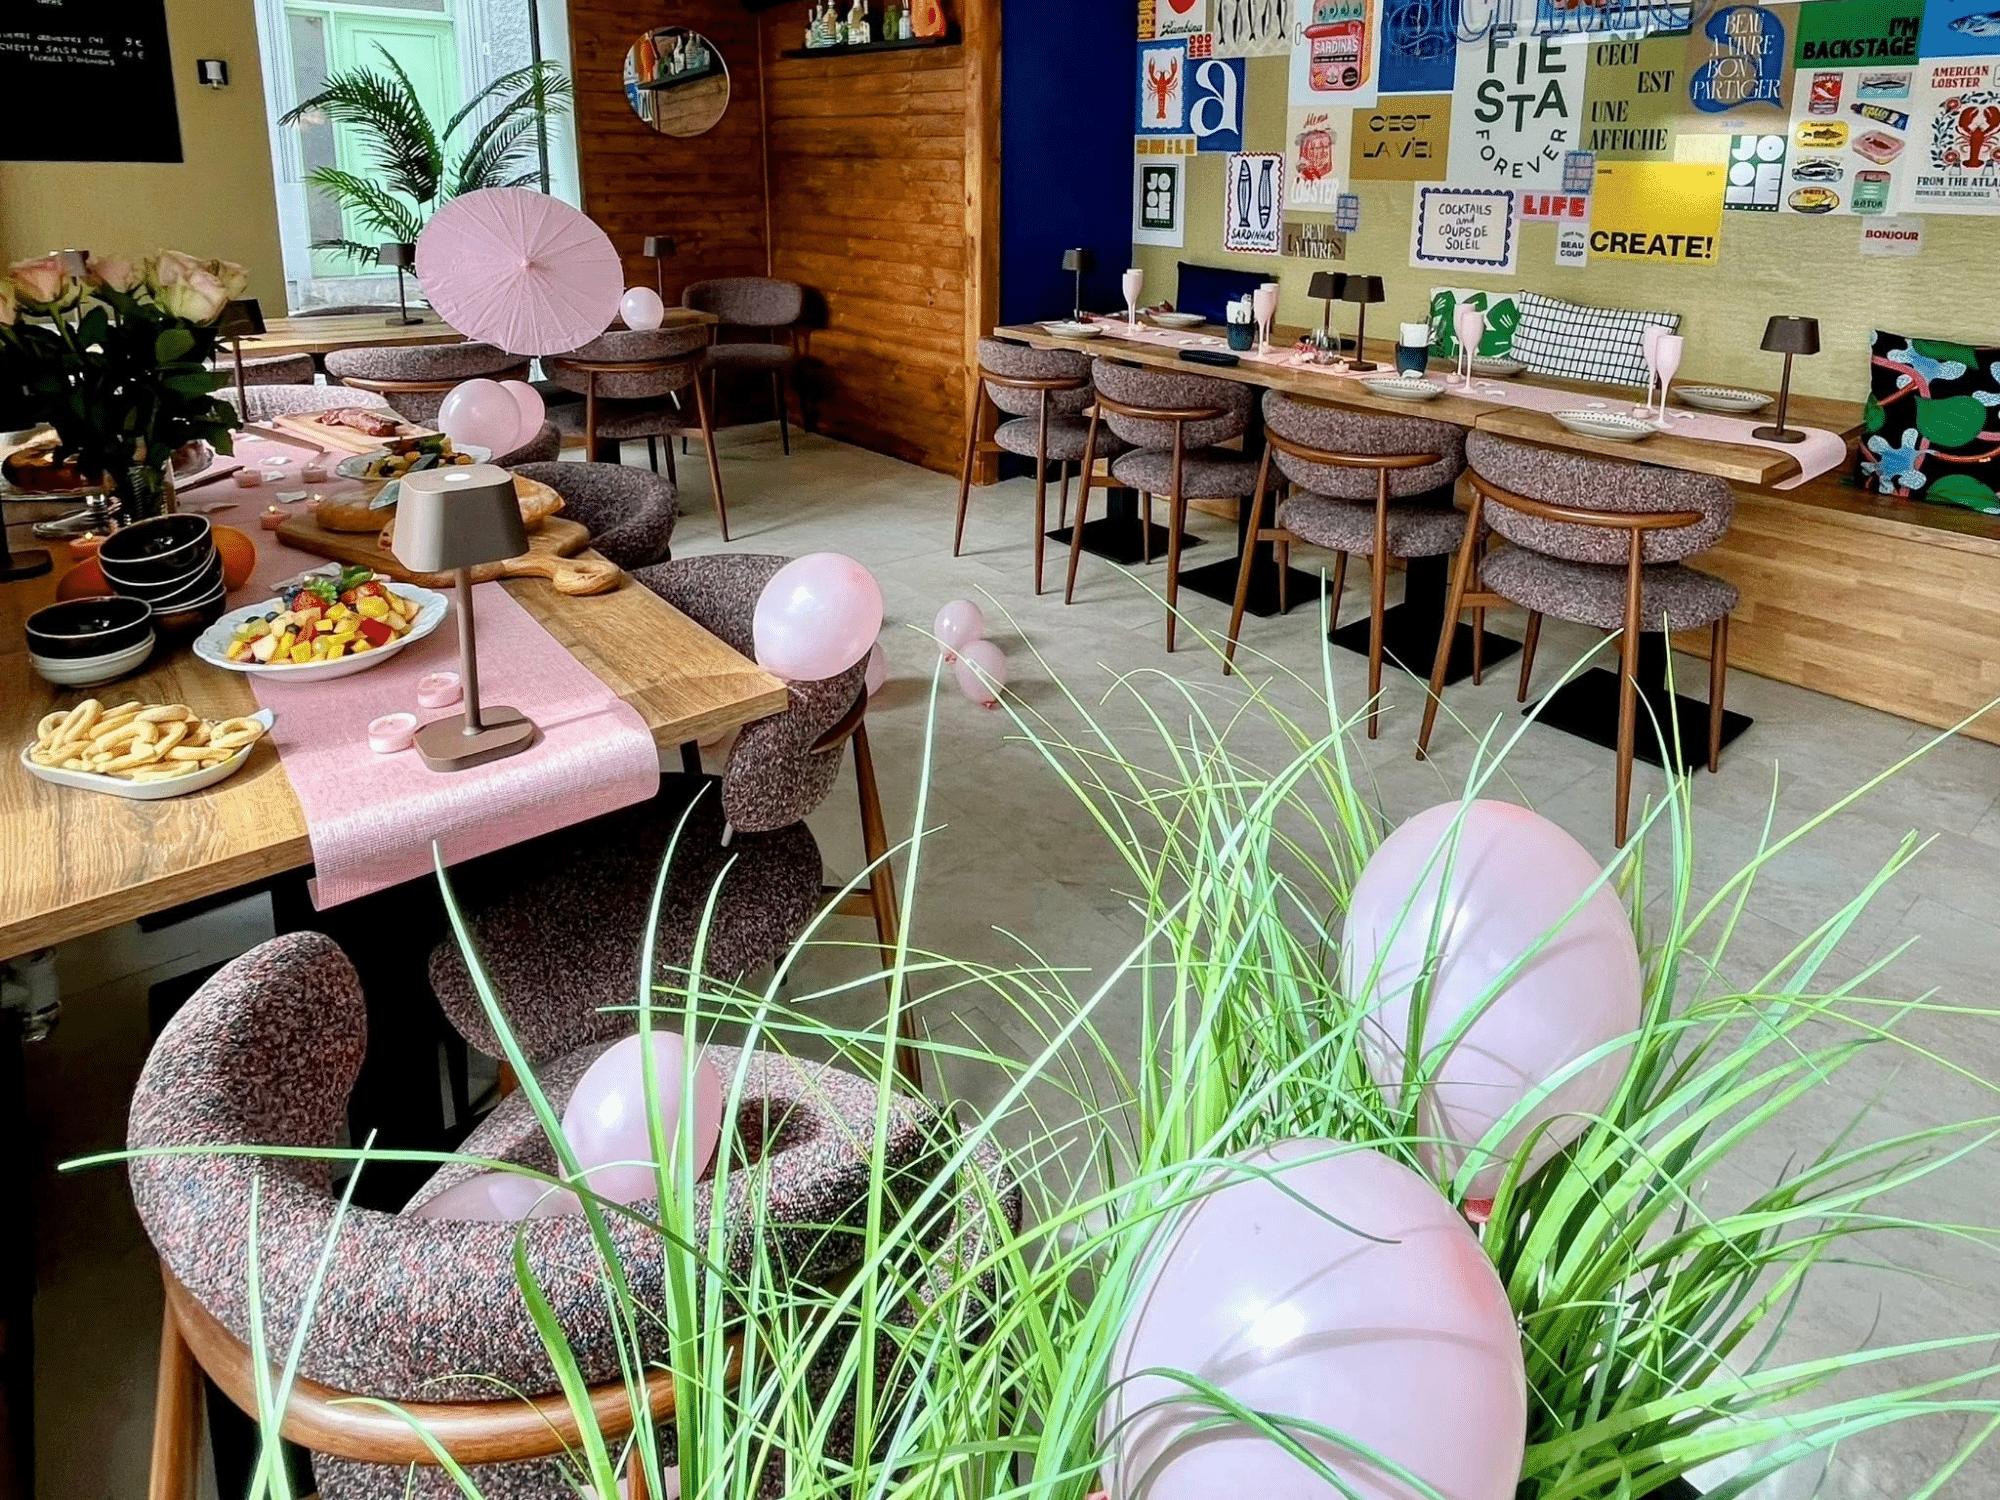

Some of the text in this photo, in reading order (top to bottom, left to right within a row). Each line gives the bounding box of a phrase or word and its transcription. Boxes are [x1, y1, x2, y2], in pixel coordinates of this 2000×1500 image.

[1724, 13, 1765, 34] BEAU
[1889, 16, 1920, 37] I'M
[1313, 39, 1359, 56] SARDINAS
[1728, 35, 1775, 55] VIVRE
[1802, 36, 1916, 60] BACKSTAGE
[1596, 43, 1640, 66] CECI
[1932, 66, 1989, 78] AMERICAN
[1637, 70, 1675, 93] EST
[1693, 79, 1780, 100] PARTAGER
[1931, 77, 1981, 88] LOBSTER
[1474, 79, 1569, 132] STA
[1591, 100, 1629, 122] UNE
[1369, 114, 1432, 132] C'EST
[1588, 128, 1668, 150] AFFICHE
[1363, 141, 1391, 158] LA
[1475, 129, 1568, 178] FOREVER
[1917, 176, 2000, 187] FROM THE ATLA
[1438, 203, 1492, 216] COCKTAILS
[1522, 195, 1586, 217] LIFE
[1456, 215, 1475, 225] and
[1230, 228, 1275, 241] SARDINHAS
[1438, 225, 1488, 238] COUPS DE
[1865, 229, 1919, 241] BONJOUR
[1444, 237, 1481, 250] SOLEIL
[1560, 241, 1585, 249] BEAU
[1590, 230, 1714, 259] CREATE!
[1560, 250, 1584, 258] COUP
